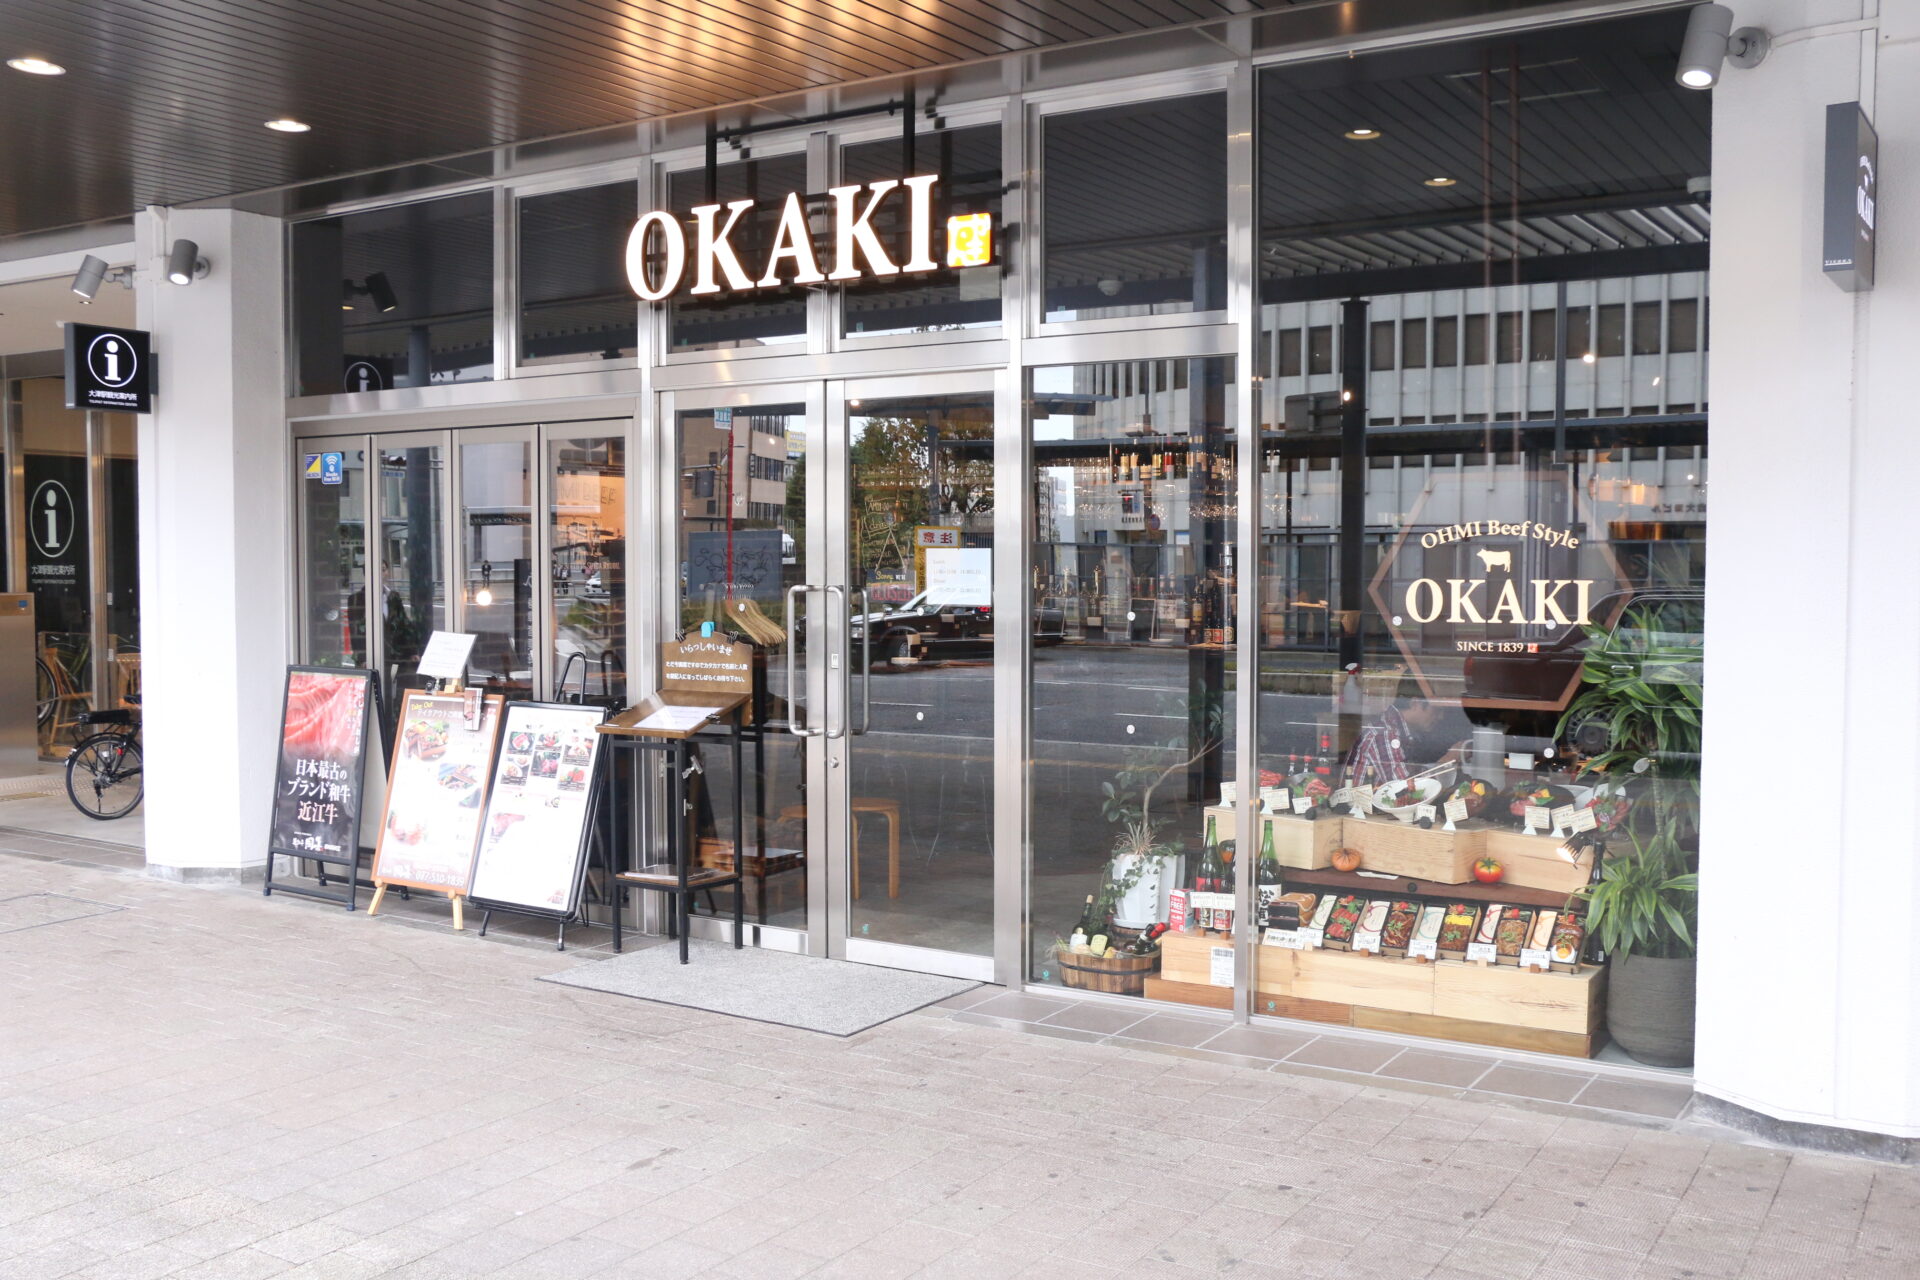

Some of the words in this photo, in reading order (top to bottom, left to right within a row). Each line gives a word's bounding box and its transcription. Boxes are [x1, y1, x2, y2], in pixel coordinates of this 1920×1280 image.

[625, 175, 940, 300] OKAKI
[1421, 521, 1481, 549] OHMI
[1487, 520, 1532, 537] Beef
[1532, 523, 1580, 549] Style
[1405, 578, 1594, 626] OKAKI
[680, 642, 733, 656] いらっしゃいませ
[1457, 641, 1494, 652] SINCE
[1497, 641, 1524, 653] 1839
[295, 758, 347, 781] 日本最古の
[287, 781, 351, 804] ブランド和牛
[297, 800, 338, 826] 近江牛
